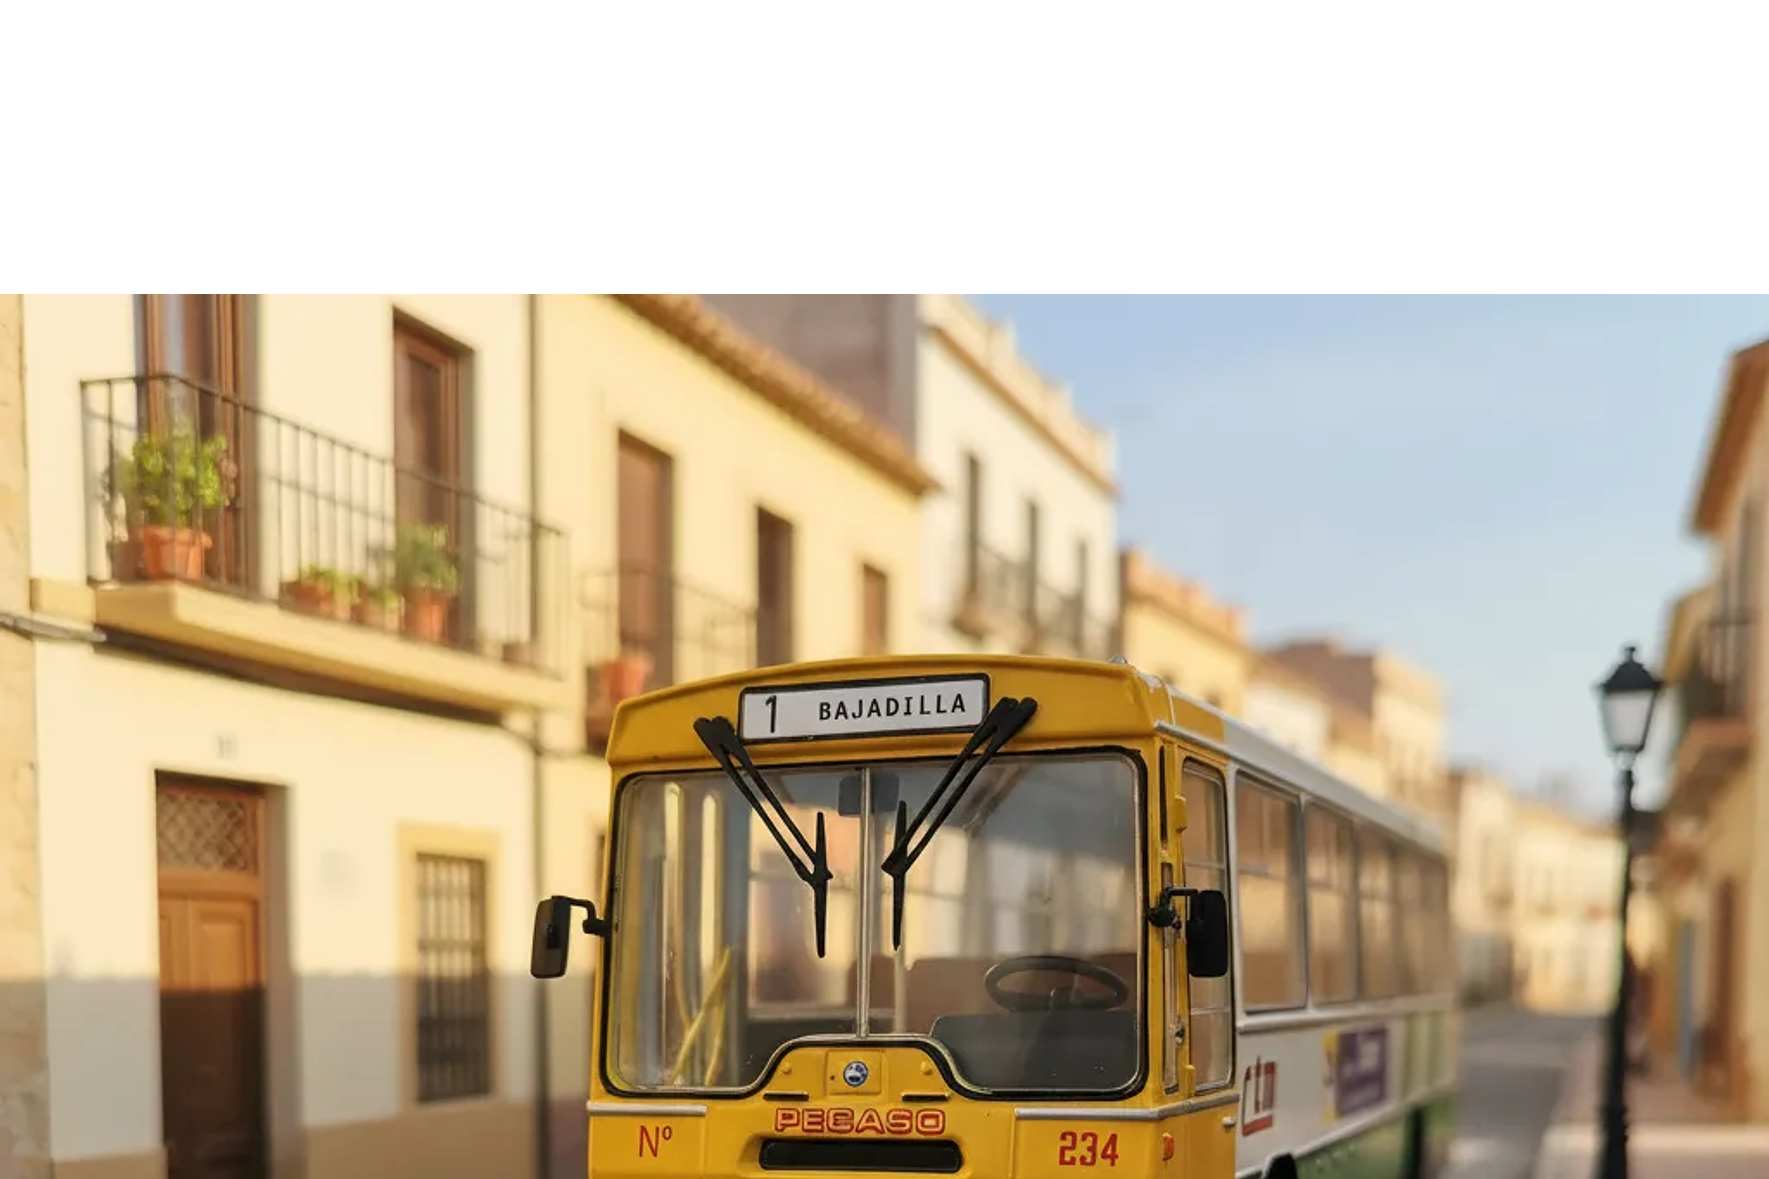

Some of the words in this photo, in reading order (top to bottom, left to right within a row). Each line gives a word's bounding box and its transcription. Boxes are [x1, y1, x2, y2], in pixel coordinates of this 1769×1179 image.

[765, 695, 778, 734] 1
[818, 693, 966, 721] BAJADILLA
[775, 1108, 945, 1135] PEGASO
[1058, 1130, 1119, 1167] 234
